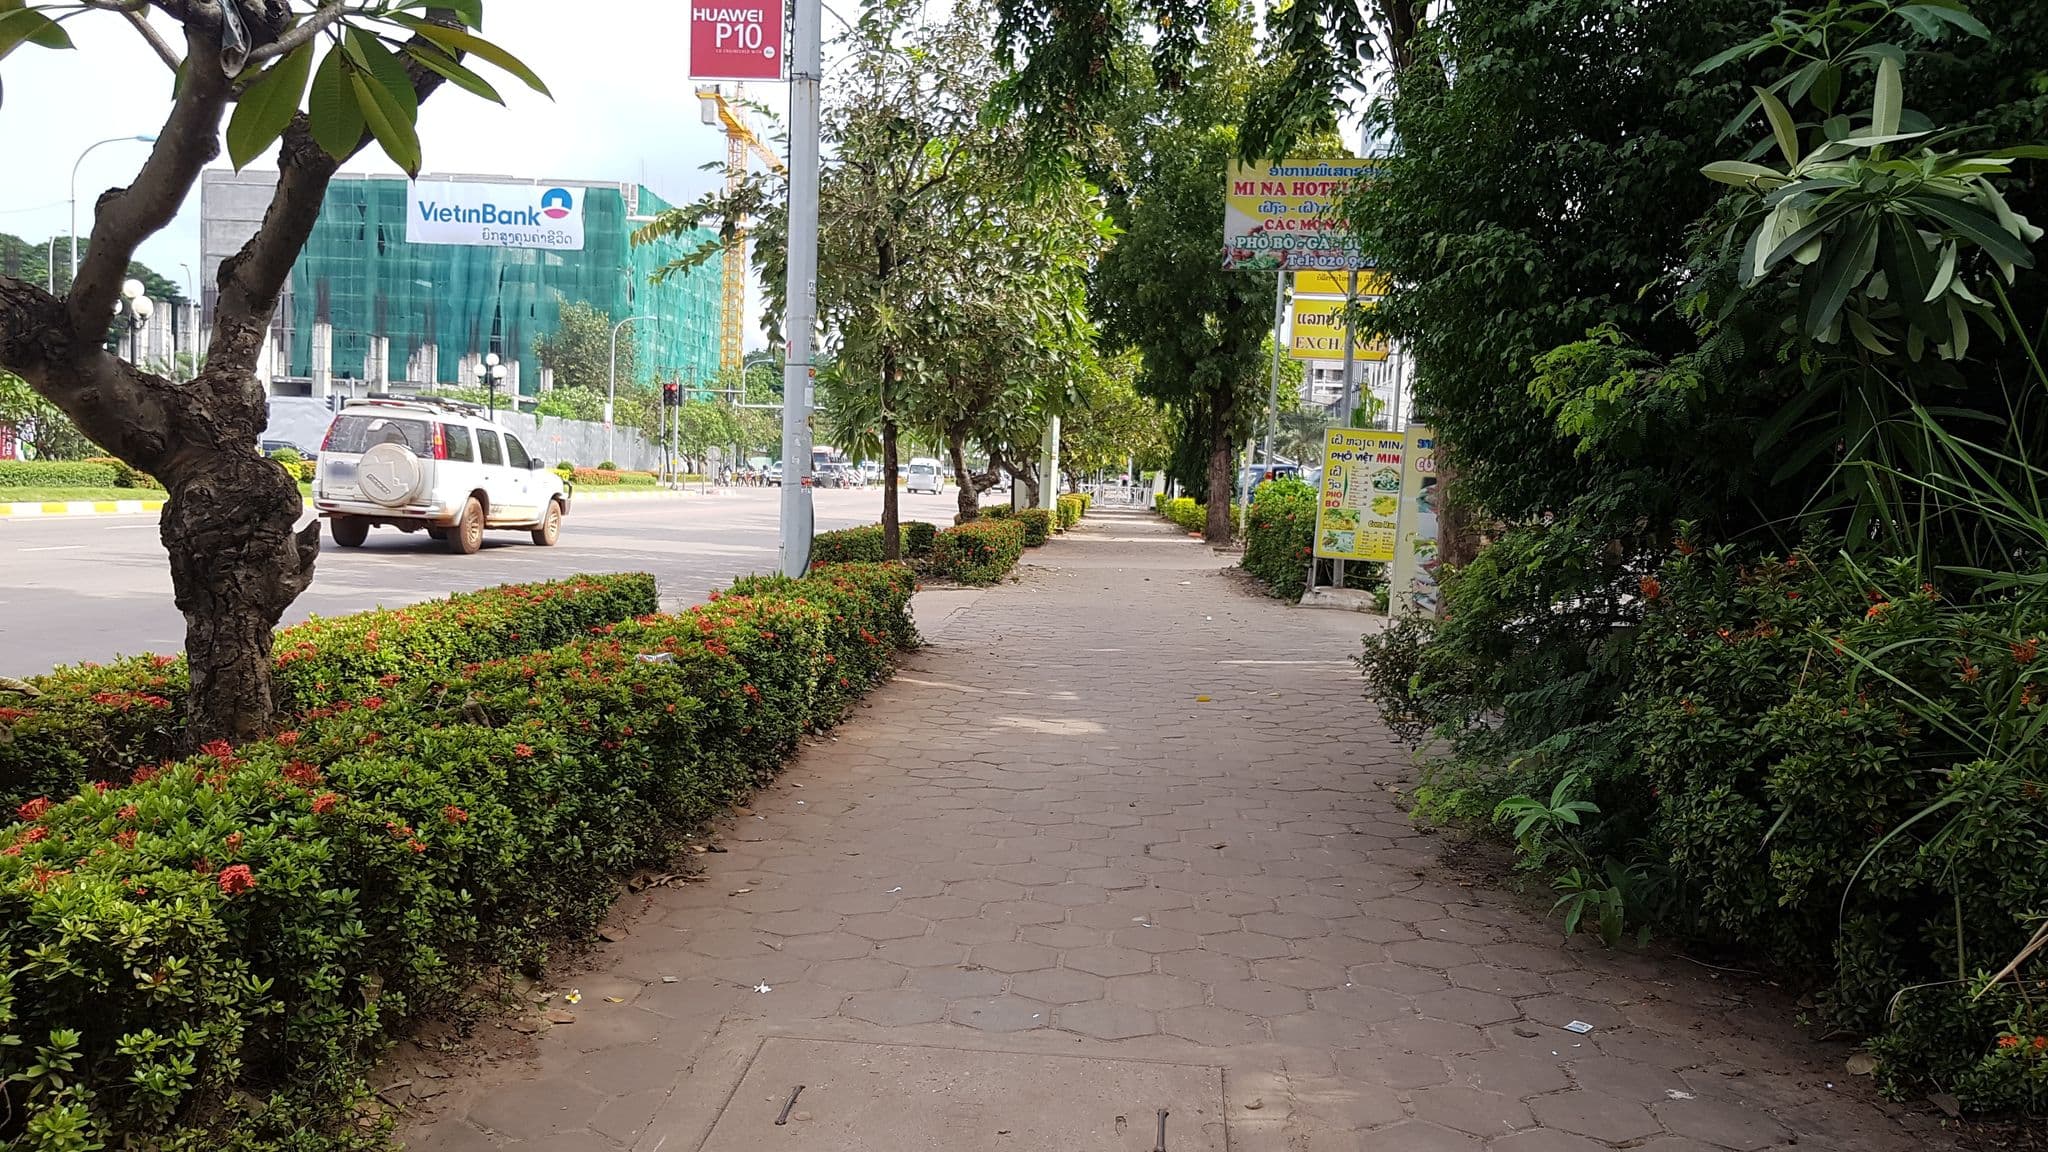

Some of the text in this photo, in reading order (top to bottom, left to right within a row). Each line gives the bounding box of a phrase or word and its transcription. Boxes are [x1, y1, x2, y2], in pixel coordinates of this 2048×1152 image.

[693, 8, 763, 22] HUAWEI
[716, 23, 763, 49] P10
[1234, 181, 1255, 196] MI
[1260, 182, 1287, 196] NA
[418, 201, 541, 226] VietinBank
[1287, 254, 1314, 267] Tel:
[1318, 256, 1345, 267] 020
[1376, 453, 1402, 464] MIN
